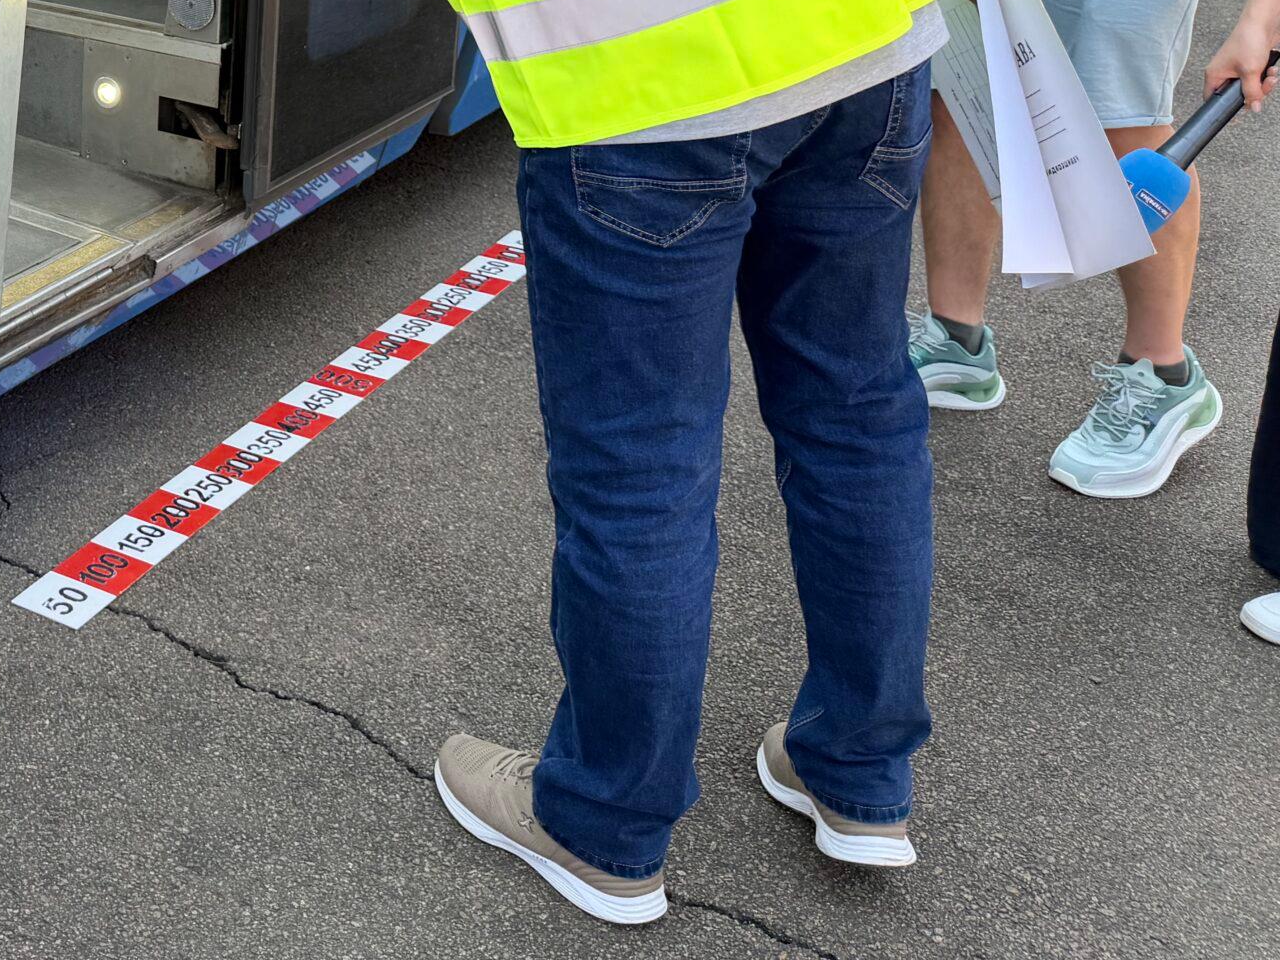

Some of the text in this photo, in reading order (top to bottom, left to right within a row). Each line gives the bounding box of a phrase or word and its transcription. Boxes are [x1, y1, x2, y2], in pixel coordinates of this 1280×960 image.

[41, 586, 88, 615] 50
[79, 553, 129, 584] 100
[117, 524, 166, 553] 150
[151, 496, 201, 529] 200
[183, 473, 233, 503] 250
[216, 450, 264, 479] 300
[246, 429, 292, 456] 350
[276, 408, 319, 433] 400
[302, 388, 343, 413] 450
[350, 351, 390, 373] 450
[373, 334, 410, 356] 400
[395, 318, 433, 339] 350
[436, 286, 473, 306] 250
[476, 260, 510, 276] 150
